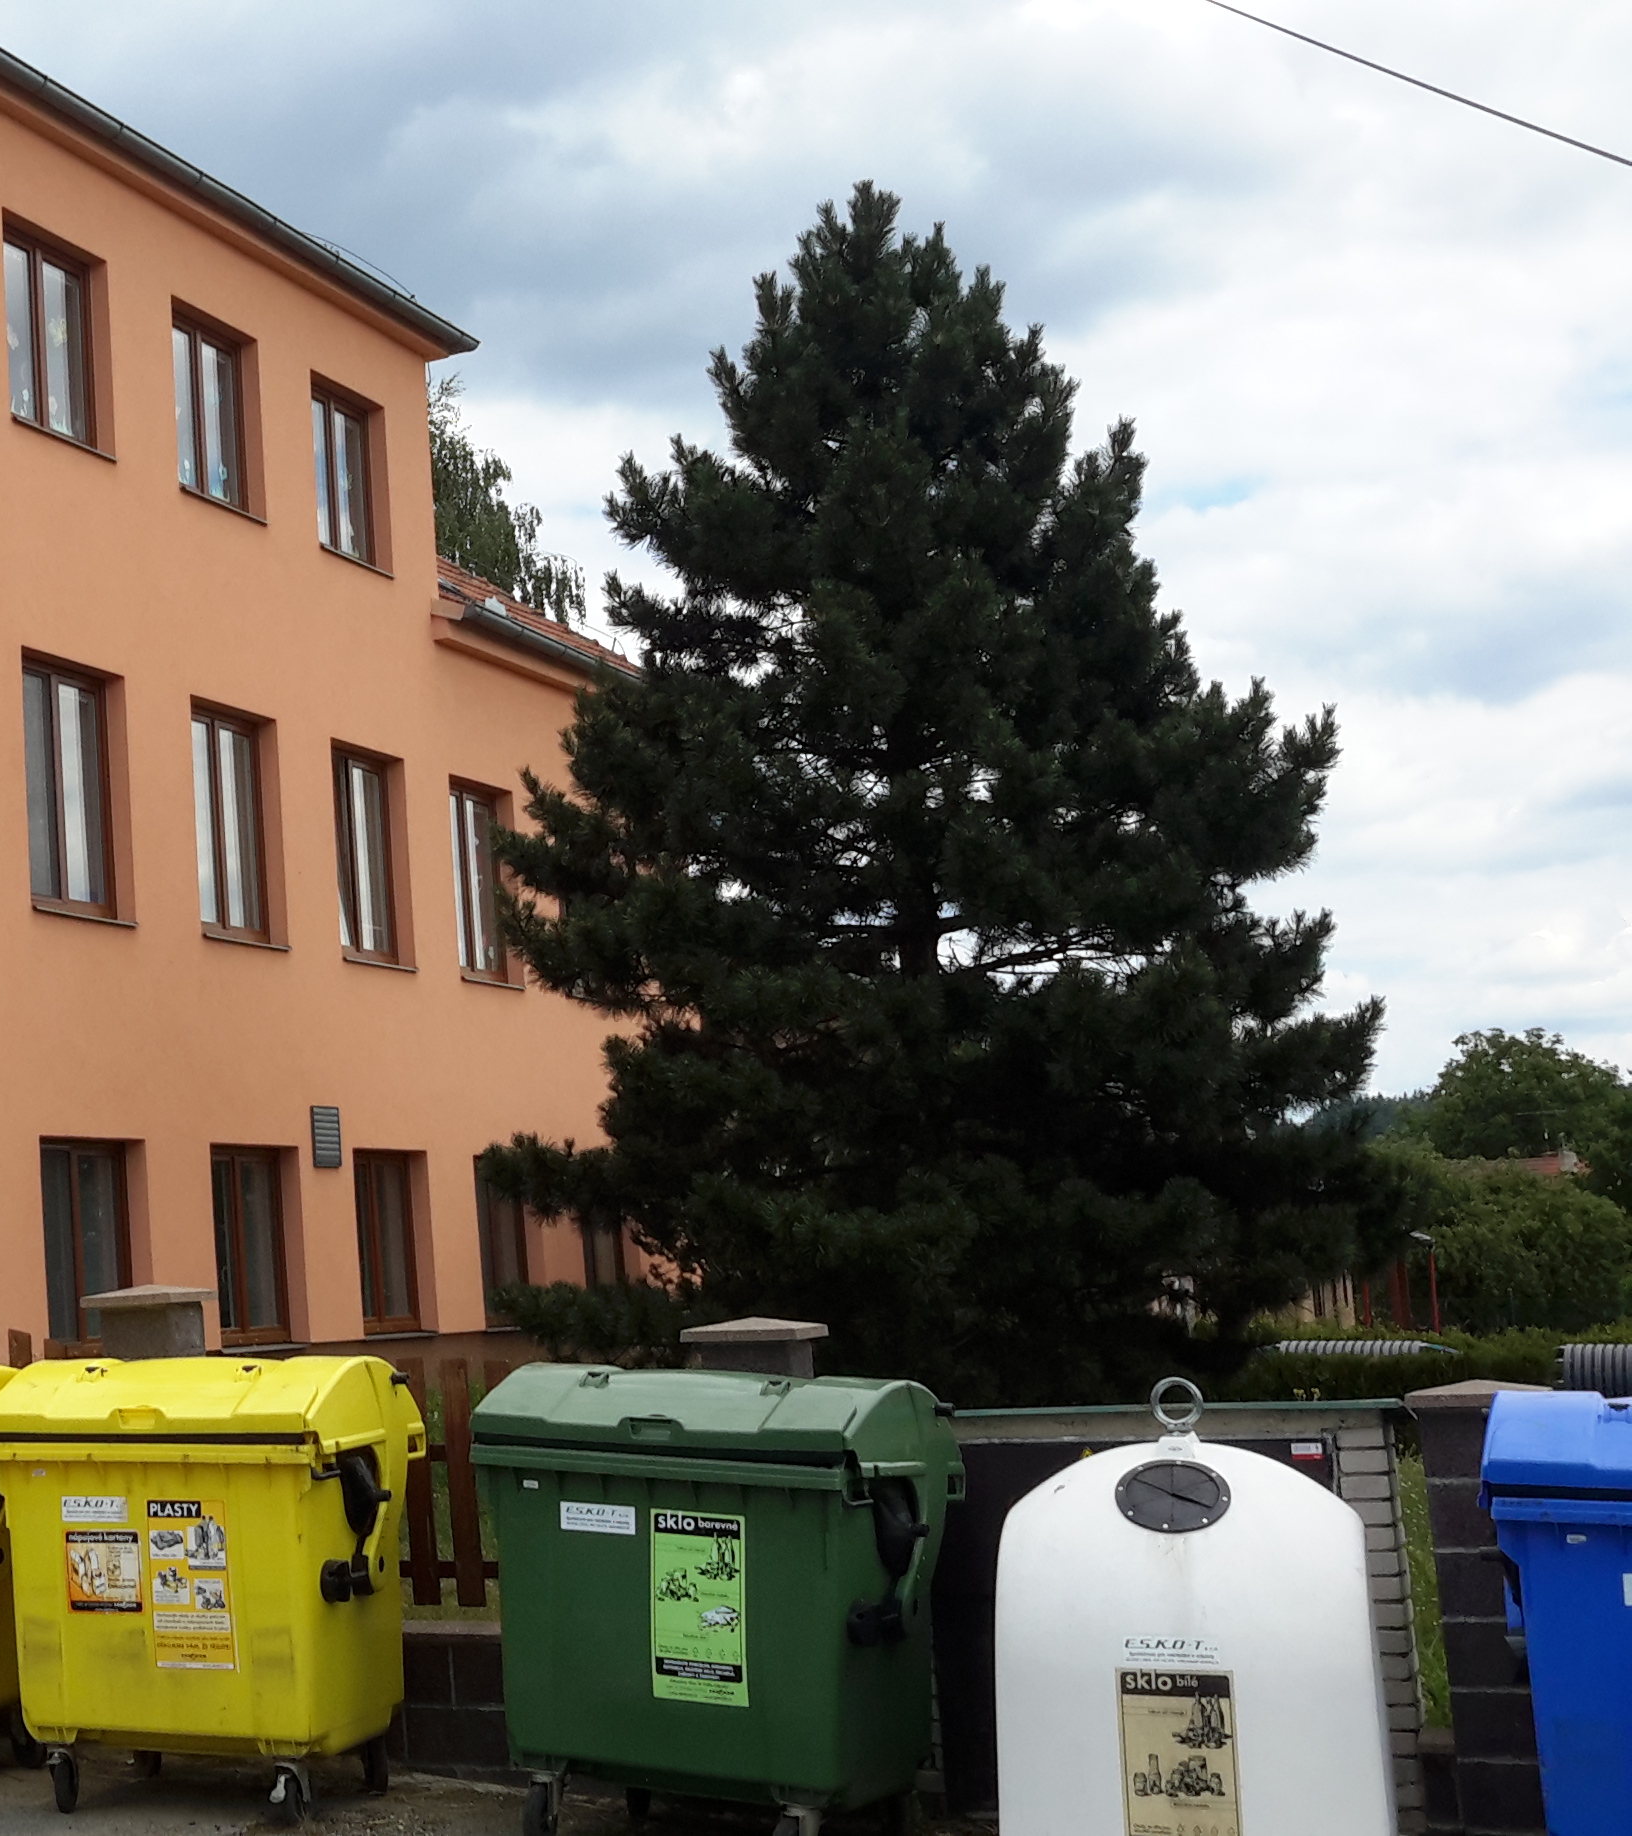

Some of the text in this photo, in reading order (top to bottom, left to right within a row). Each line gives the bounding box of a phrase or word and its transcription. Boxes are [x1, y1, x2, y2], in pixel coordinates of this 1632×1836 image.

[149, 1503, 199, 1518] PLASTY
[657, 1511, 739, 1532] sklo barevné
[1125, 1669, 1173, 1691] sklo
